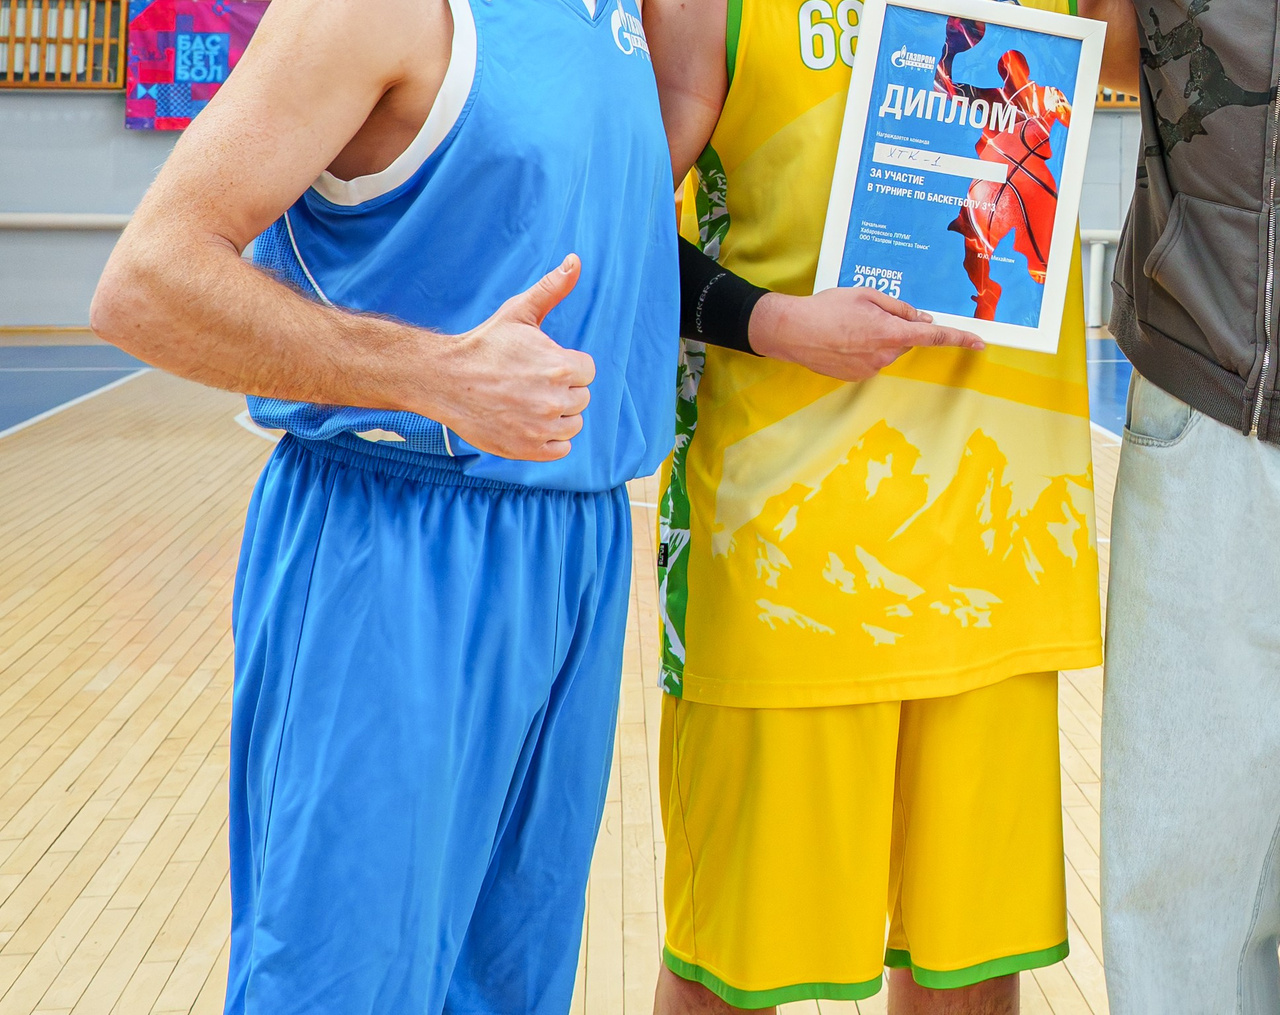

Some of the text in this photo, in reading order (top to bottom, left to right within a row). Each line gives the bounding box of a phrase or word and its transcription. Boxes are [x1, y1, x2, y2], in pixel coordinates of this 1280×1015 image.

[177, 34, 221, 51] БАС
[177, 50, 219, 65] КЕТ
[906, 52, 935, 64] ГАЗПРОМ
[177, 65, 222, 82] БОЛ
[878, 84, 1018, 134] ДИПЛОМ
[909, 137, 930, 145] команда
[870, 168, 925, 185] ЗА УЧАСТИЕ
[867, 182, 874, 192] В
[876, 184, 912, 198] ТУРНИРЕ
[914, 191, 926, 201] ПО
[927, 192, 980, 209] БАСКЕТБОЛУ
[854, 264, 903, 281] ХАБАРОВСК
